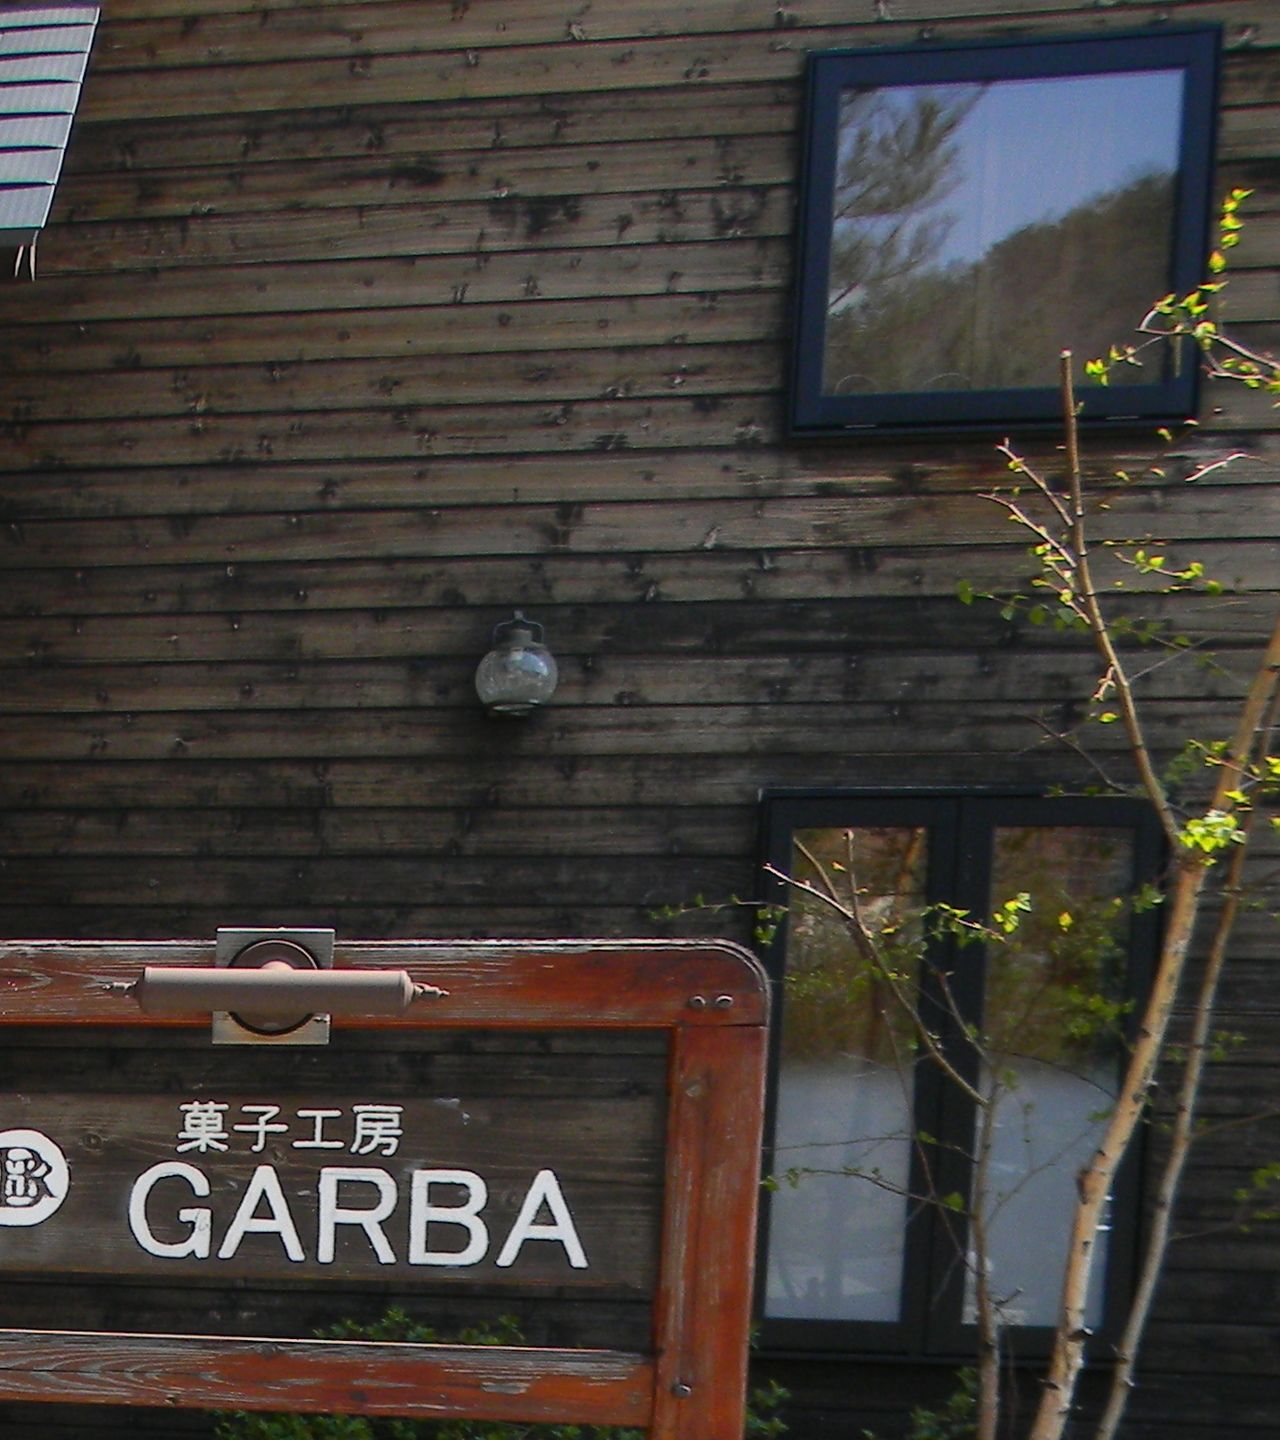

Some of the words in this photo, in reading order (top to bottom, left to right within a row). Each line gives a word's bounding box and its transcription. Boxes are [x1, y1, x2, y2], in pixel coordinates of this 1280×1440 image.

[176, 1101, 404, 1157] 菓子工房
[128, 1160, 589, 1269] GARBA
